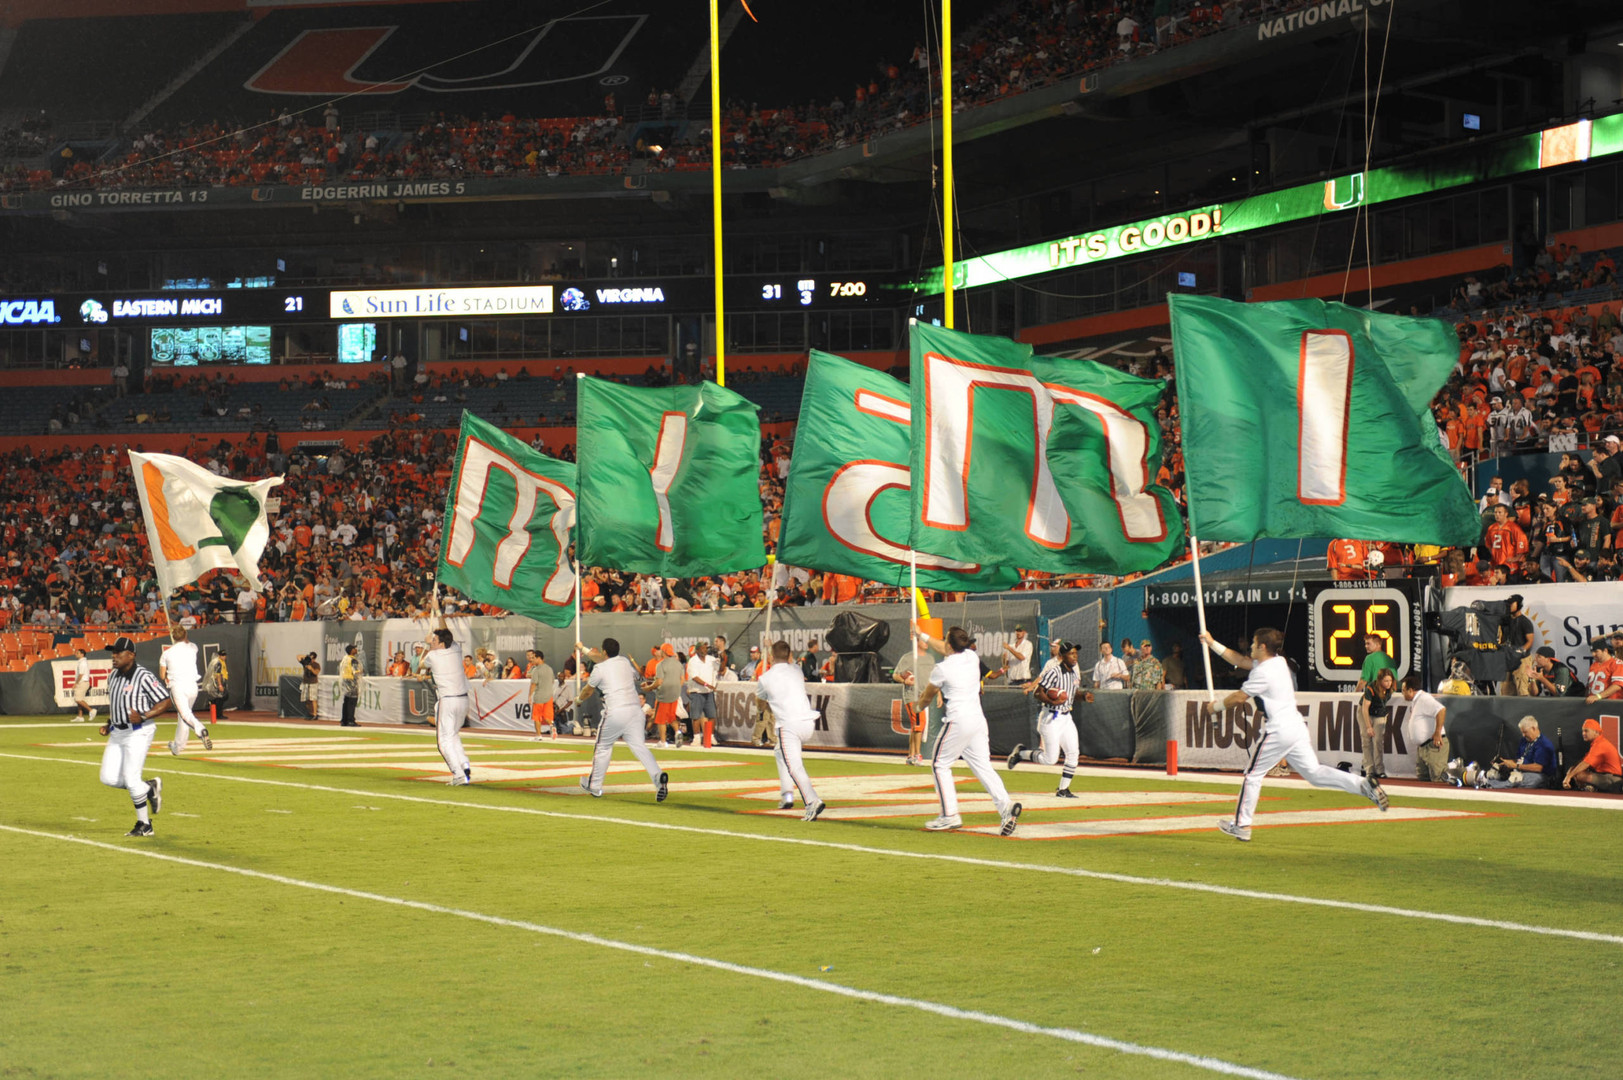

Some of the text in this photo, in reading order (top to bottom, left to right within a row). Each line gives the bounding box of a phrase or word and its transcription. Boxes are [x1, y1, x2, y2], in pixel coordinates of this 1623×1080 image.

[1258, 0, 1363, 41] NATIONAL
[51, 191, 207, 207] GINO TORRETTA 13
[302, 183, 465, 200] EDGERRIN JAMES 5
[1050, 209, 1222, 267] IT'S GOOD!
[596, 287, 664, 303] VIRGINIA
[762, 284, 781, 299] 31
[830, 282, 866, 296] 7:00
[113, 299, 222, 317] EASTERN MICH
[285, 297, 303, 311] 21
[366, 292, 545, 315] Sun Life STADIUM
[1493, 534, 1502, 548] 2
[1344, 544, 1357, 560] 3
[1329, 604, 1394, 665] 25
